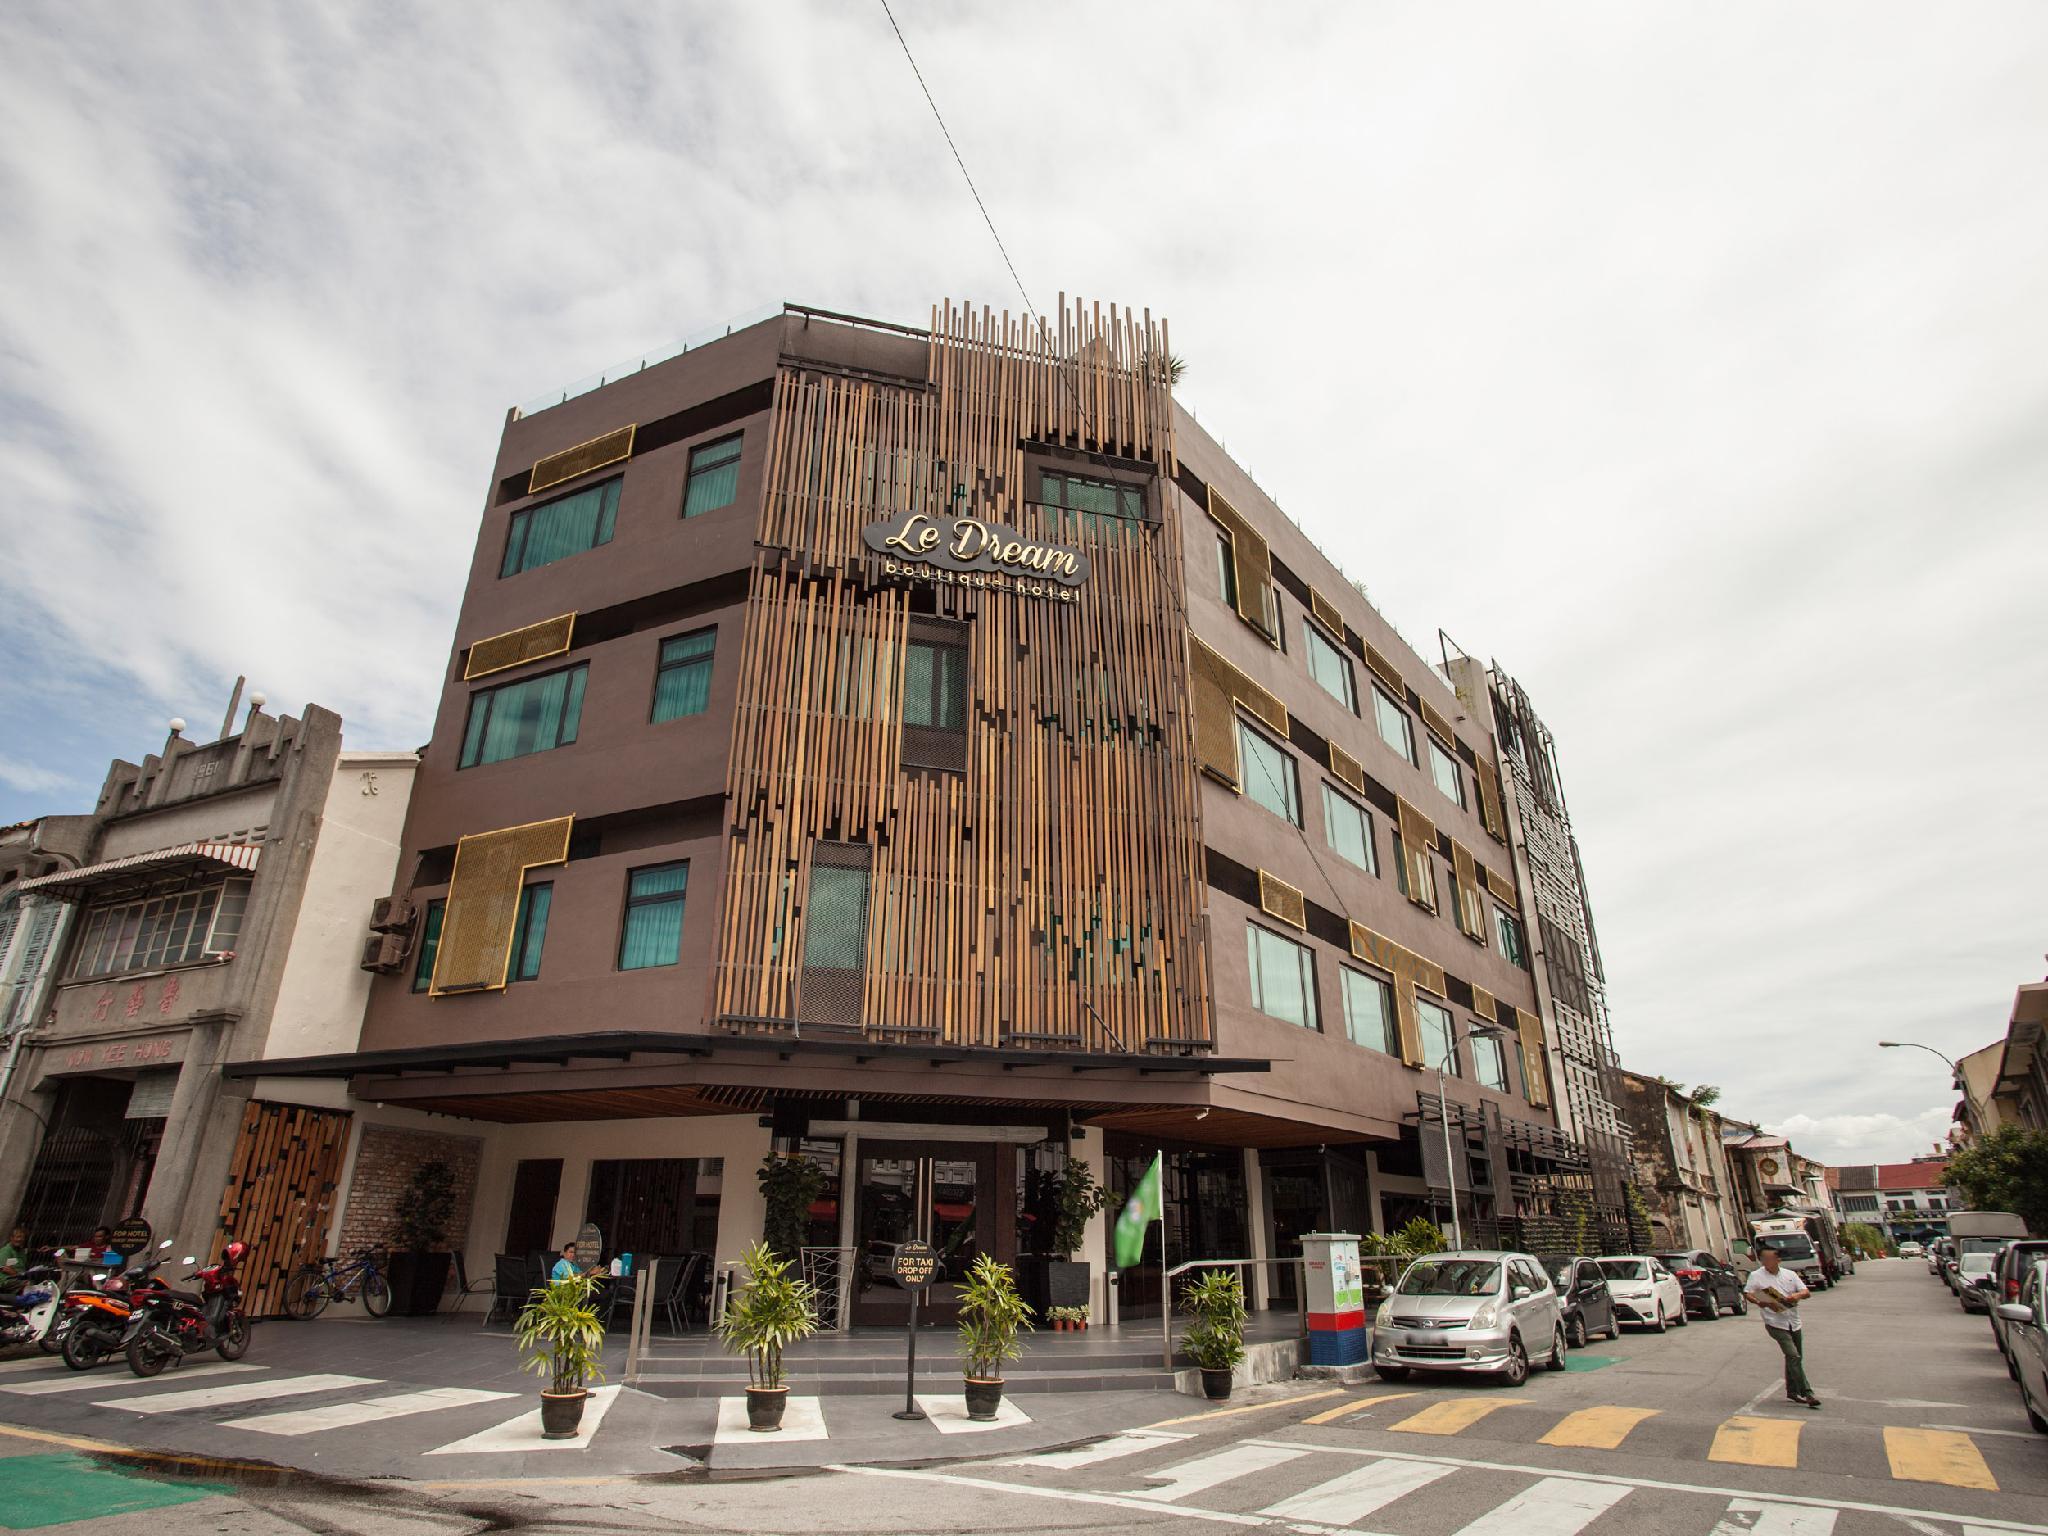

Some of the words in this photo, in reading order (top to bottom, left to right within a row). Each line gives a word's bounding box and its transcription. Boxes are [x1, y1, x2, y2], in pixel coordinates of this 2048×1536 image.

[885, 514, 941, 554] Le
[949, 519, 1079, 575] Dream
[886, 560, 1001, 590] boutique
[1016, 581, 1081, 603] hotel
[897, 1257, 914, 1266] FOR
[915, 1257, 934, 1267] TAXI
[897, 1266, 918, 1274] DROP
[918, 1267, 933, 1275] OFF
[905, 1274, 924, 1283] ONLY
